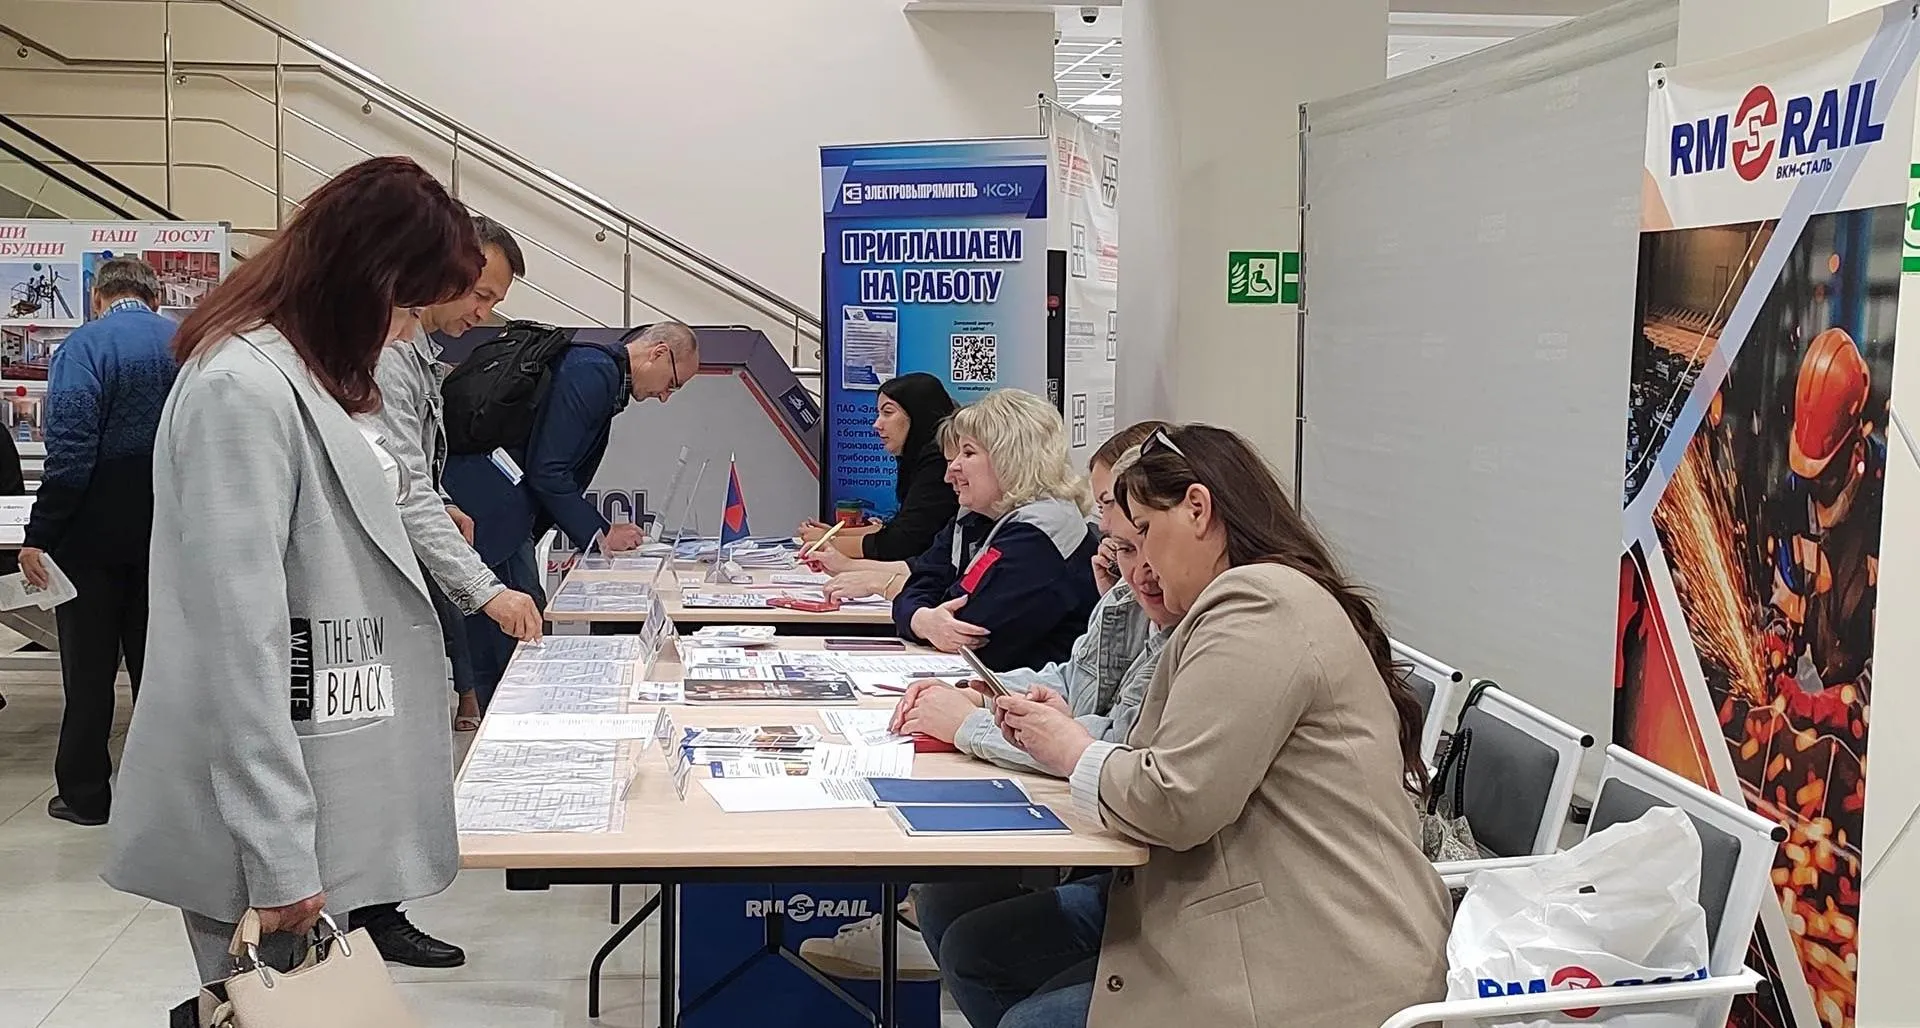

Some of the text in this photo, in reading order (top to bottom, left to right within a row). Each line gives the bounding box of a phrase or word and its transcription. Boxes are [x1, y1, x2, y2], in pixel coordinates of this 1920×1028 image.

[1670, 114, 1729, 177] RM
[1778, 79, 1885, 159] RAIL
[1776, 157, 1833, 180] ВКМ-СТАЛЬ
[865, 183, 978, 200] ЭЛЕКТРОВЫПРЯМИТЕЛЬ
[91, 229, 215, 245] НАШ ДОСУГ
[842, 228, 1023, 263] ПРИГЛАШАЕМ
[0, 242, 65, 257] БУДНИ
[862, 269, 1004, 303] НА РАБОТУ
[837, 404, 856, 413] ПАО
[837, 452, 881, 463] приборов
[837, 466, 881, 476] отраслей
[837, 478, 892, 488] транспорта
[319, 616, 384, 664] THE NEW
[290, 631, 310, 708] WHITE
[327, 666, 386, 717] BLACK
[816, 900, 873, 917] RAIL
